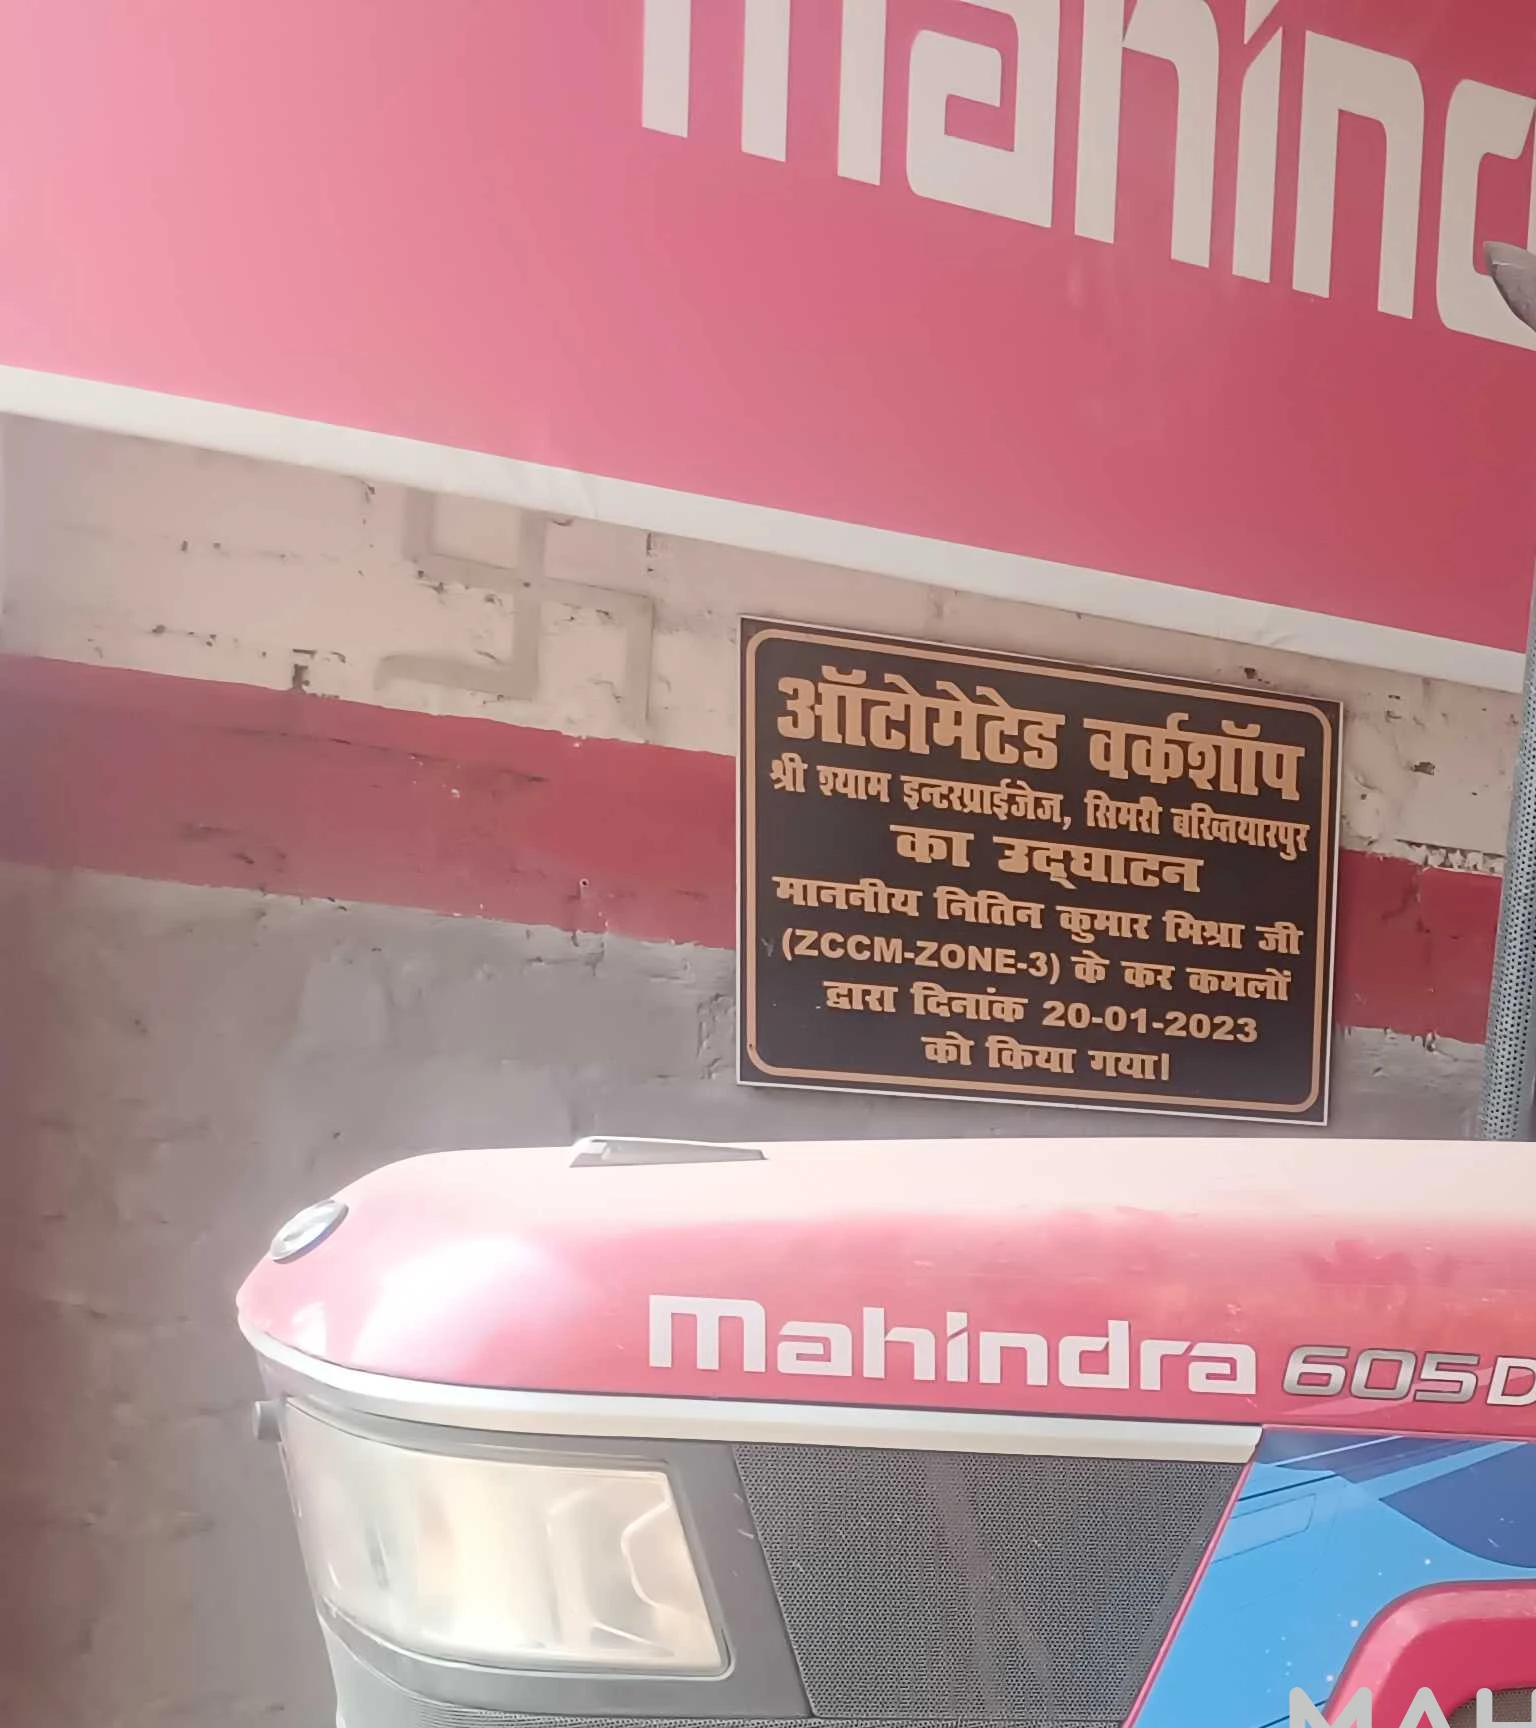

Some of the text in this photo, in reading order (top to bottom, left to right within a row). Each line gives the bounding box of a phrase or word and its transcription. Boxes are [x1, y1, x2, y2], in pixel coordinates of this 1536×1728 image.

[777, 665, 1305, 800] ऑटोमेटेड वर्कशॉप
[770, 752, 808, 792] श्री
[816, 765, 892, 802] श्याम
[1084, 790, 1162, 834] सिमरी
[890, 825, 974, 867] का
[772, 876, 1303, 954] माननीय नितिन कुमार मिश्रा जी
[782, 928, 1291, 1000] (ZCCM-ZONE-3) के कर कमलों
[823, 981, 1257, 1042] द्वारा दिनांक 20-01-2023
[921, 1031, 975, 1065] को
[985, 1035, 1077, 1073] किया
